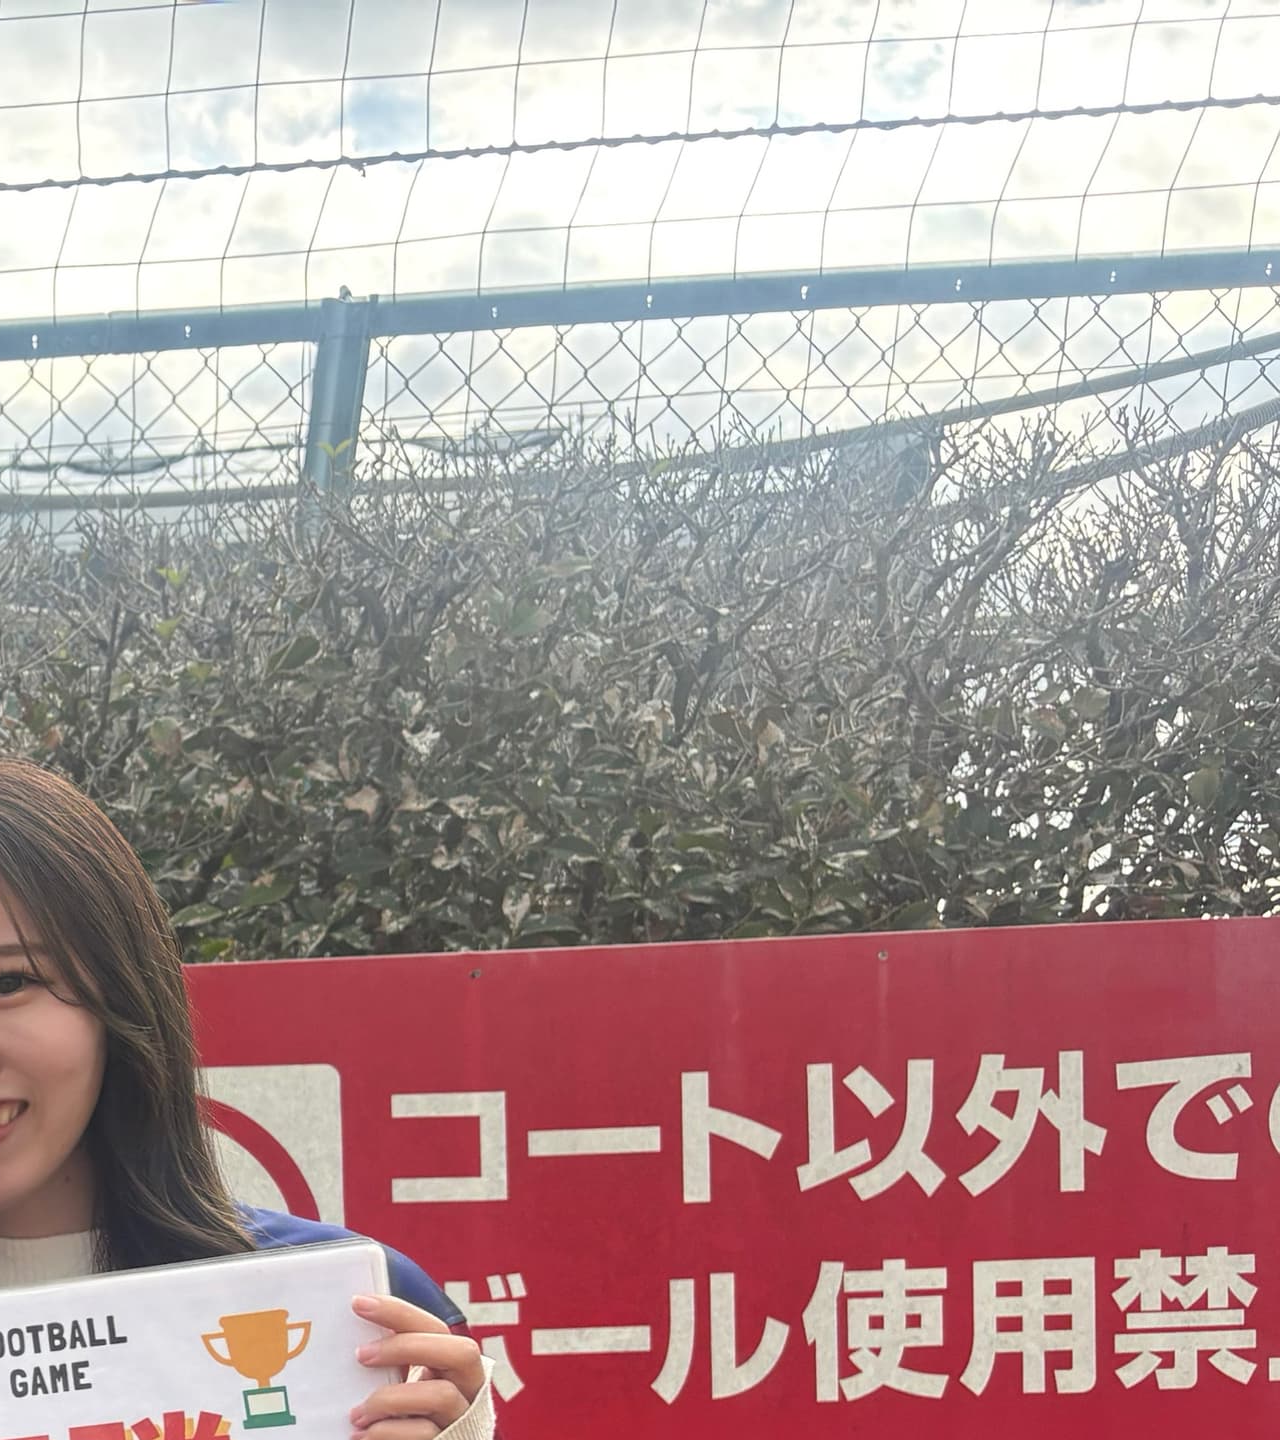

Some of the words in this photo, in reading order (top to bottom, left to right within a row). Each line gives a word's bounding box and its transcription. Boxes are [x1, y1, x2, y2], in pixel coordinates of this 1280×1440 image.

[391, 1050, 1280, 1203] コート以外で
[9, 1360, 92, 1398] GAME
[445, 1246, 1280, 1404] ボール使用禁
